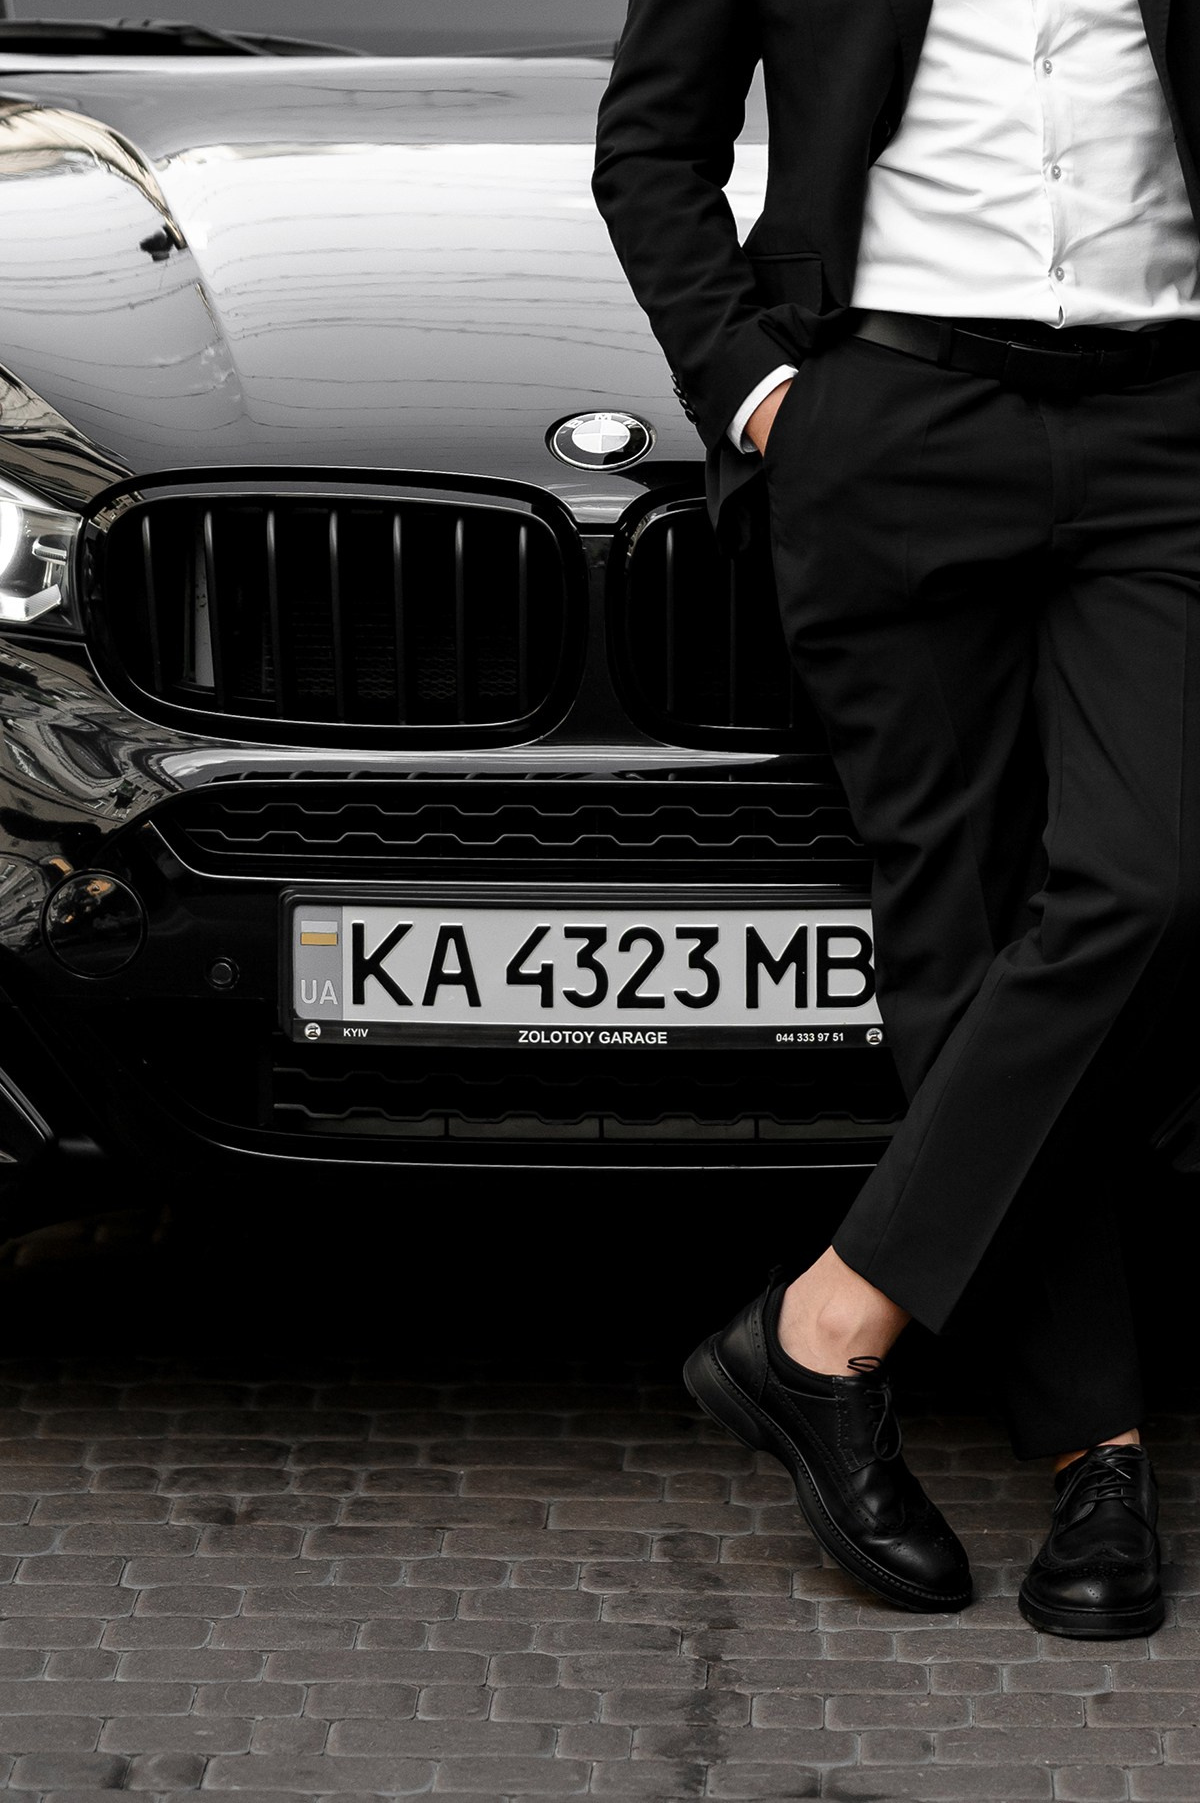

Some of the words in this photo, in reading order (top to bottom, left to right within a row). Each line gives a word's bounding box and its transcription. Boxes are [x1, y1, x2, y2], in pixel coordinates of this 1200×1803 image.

[564, 414, 641, 429] BMW
[351, 921, 482, 1008] KA
[506, 924, 721, 1009] 4323
[745, 924, 876, 1009] MB
[300, 979, 339, 1005] UA
[343, 1027, 369, 1038] KYIV
[518, 1030, 595, 1044] ZOLOTOY
[598, 1031, 668, 1045] GARAGE
[775, 1032, 795, 1043] 044
[796, 1032, 815, 1043] 333
[817, 1032, 830, 1042] 97
[832, 1032, 844, 1042] 51
